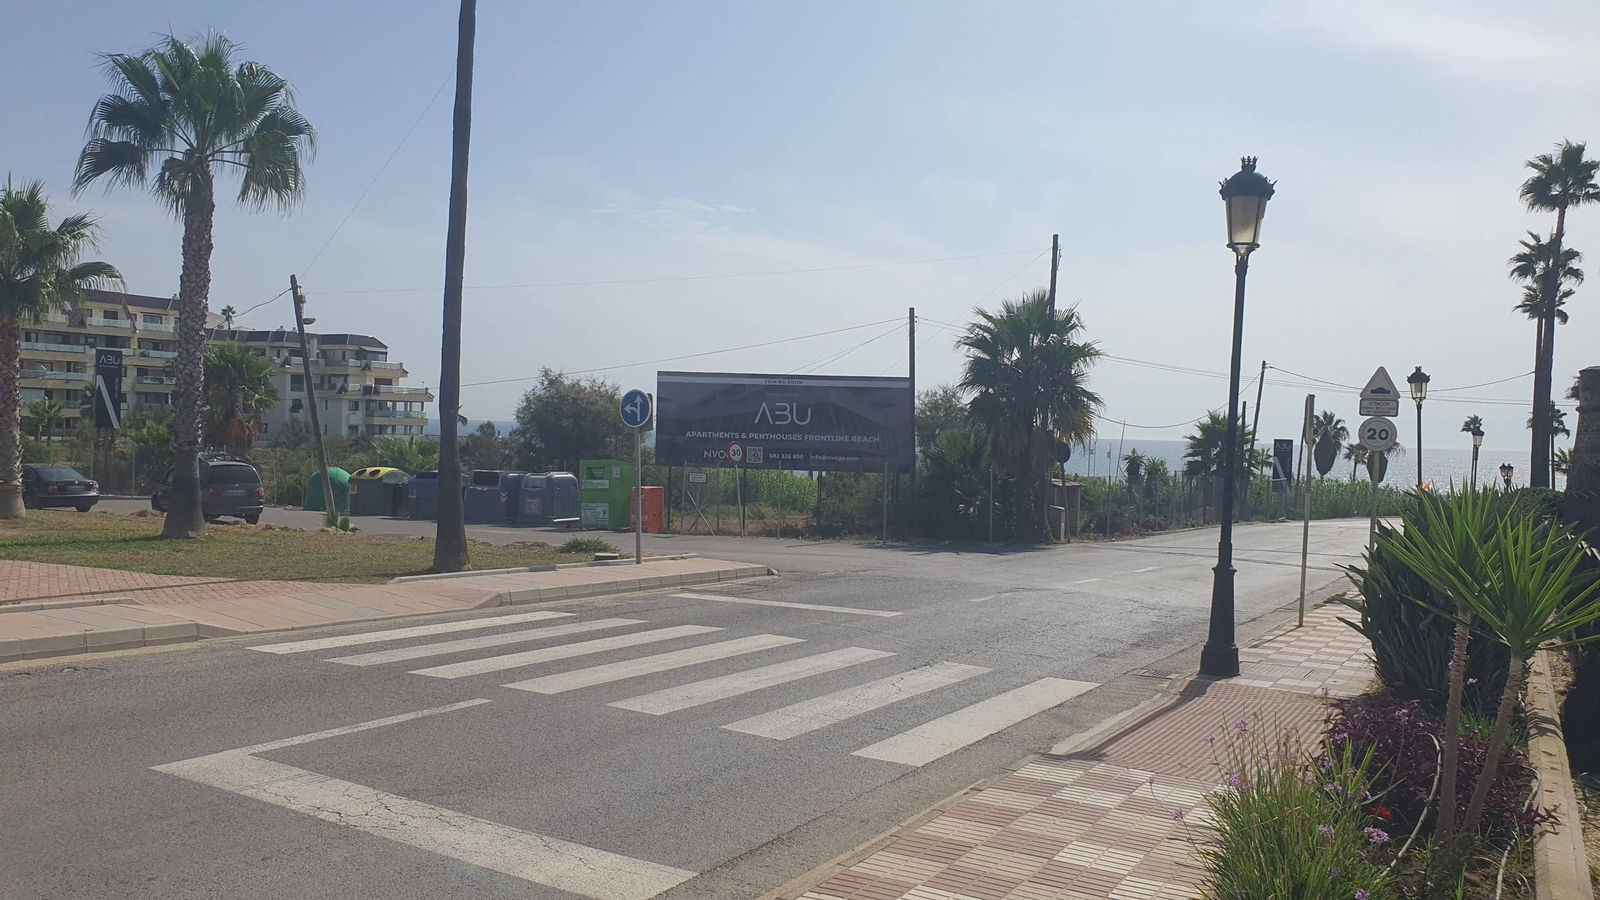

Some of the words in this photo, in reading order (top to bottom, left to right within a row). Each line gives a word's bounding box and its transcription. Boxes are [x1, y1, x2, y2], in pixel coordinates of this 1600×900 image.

[99, 355, 120, 365] ABU
[754, 401, 811, 425] ABU
[685, 431, 740, 439] APARTMENTS
[749, 432, 803, 441] PENTHOUSES
[804, 434, 850, 442] FRONTLINE
[851, 435, 880, 443] BEACH
[1366, 427, 1389, 441] 20
[703, 449, 729, 459] NVO
[731, 448, 741, 457] 30
